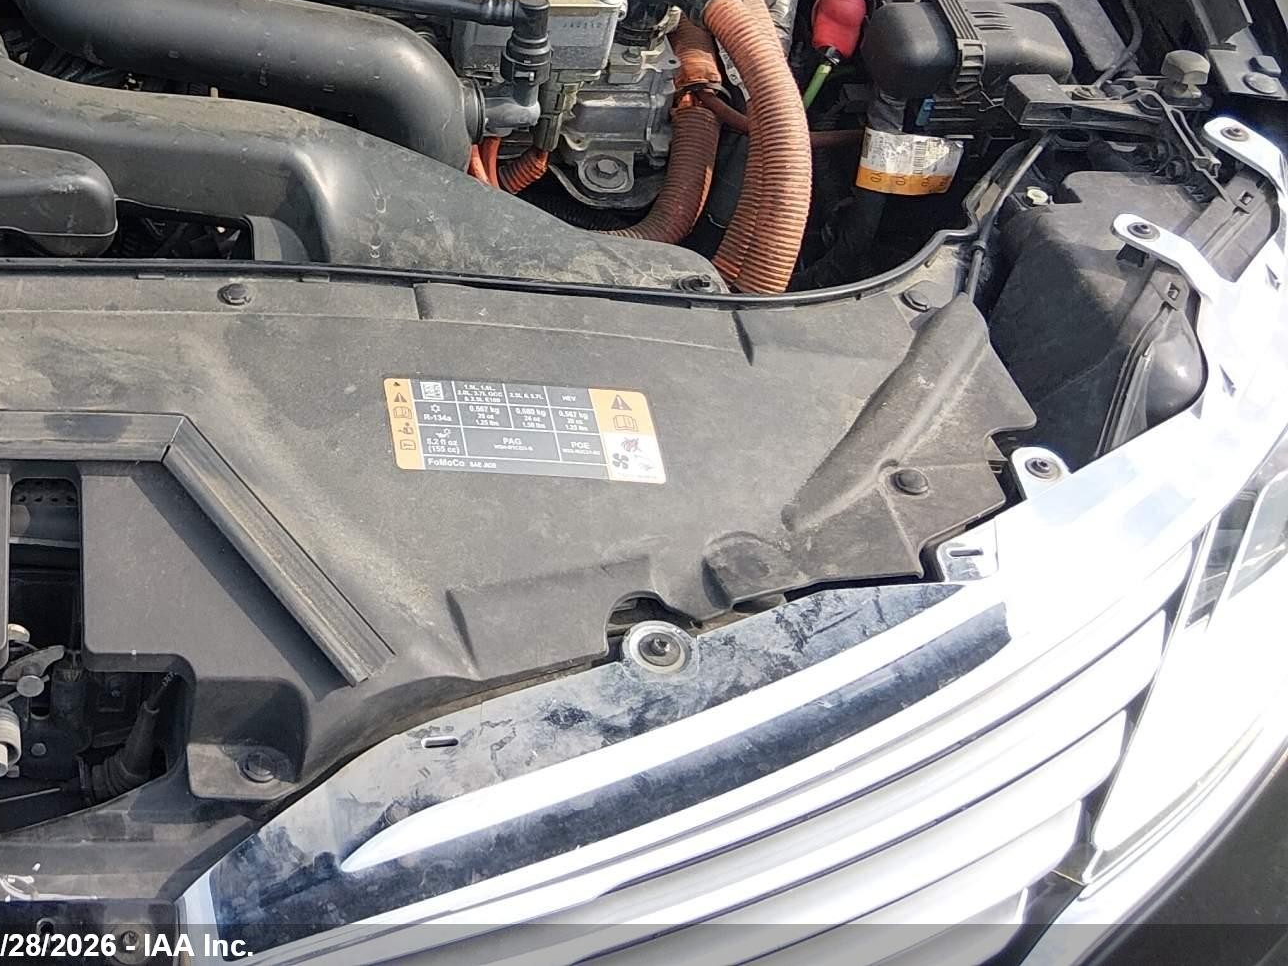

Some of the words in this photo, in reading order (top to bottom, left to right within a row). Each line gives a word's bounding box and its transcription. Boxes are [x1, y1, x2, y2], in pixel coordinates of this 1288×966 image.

[423, 413, 452, 422] R-134a
[502, 437, 522, 445] PAG
[570, 441, 591, 450] POE
[427, 458, 465, 467] FoMoCo
